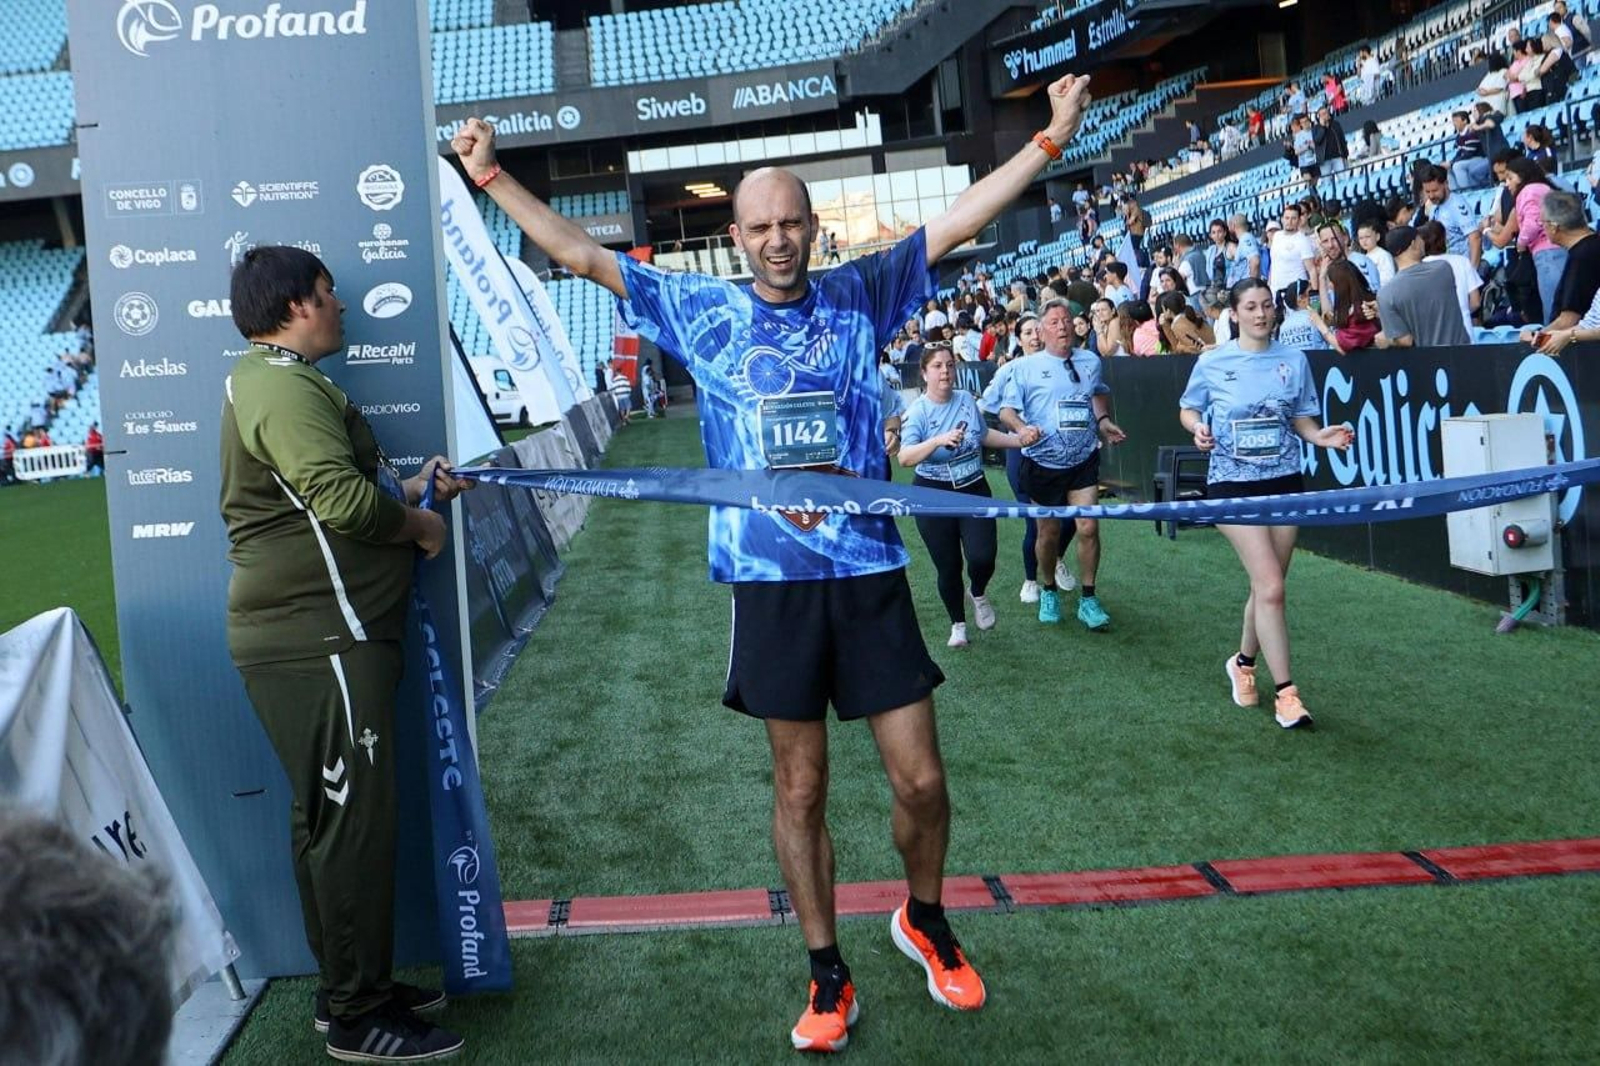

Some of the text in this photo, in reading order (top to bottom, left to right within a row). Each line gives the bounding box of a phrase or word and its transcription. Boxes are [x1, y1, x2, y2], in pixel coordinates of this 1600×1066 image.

[191, 0, 367, 41] Profand
[1022, 28, 1077, 75] hummel
[636, 92, 706, 121] Siweb
[109, 187, 167, 200] CONCELLO
[116, 199, 161, 211] DE VIGO
[134, 246, 197, 266] Coplaca
[361, 342, 417, 359] Recalvi
[391, 356, 415, 365] Parts
[119, 357, 188, 378] Adeslas
[125, 410, 174, 420] COLEGIO
[773, 420, 828, 447] 1142
[1323, 366, 1482, 486] Galic
[1238, 433, 1276, 448] 2095
[132, 521, 195, 539] MRW
[458, 890, 488, 979] Profand
